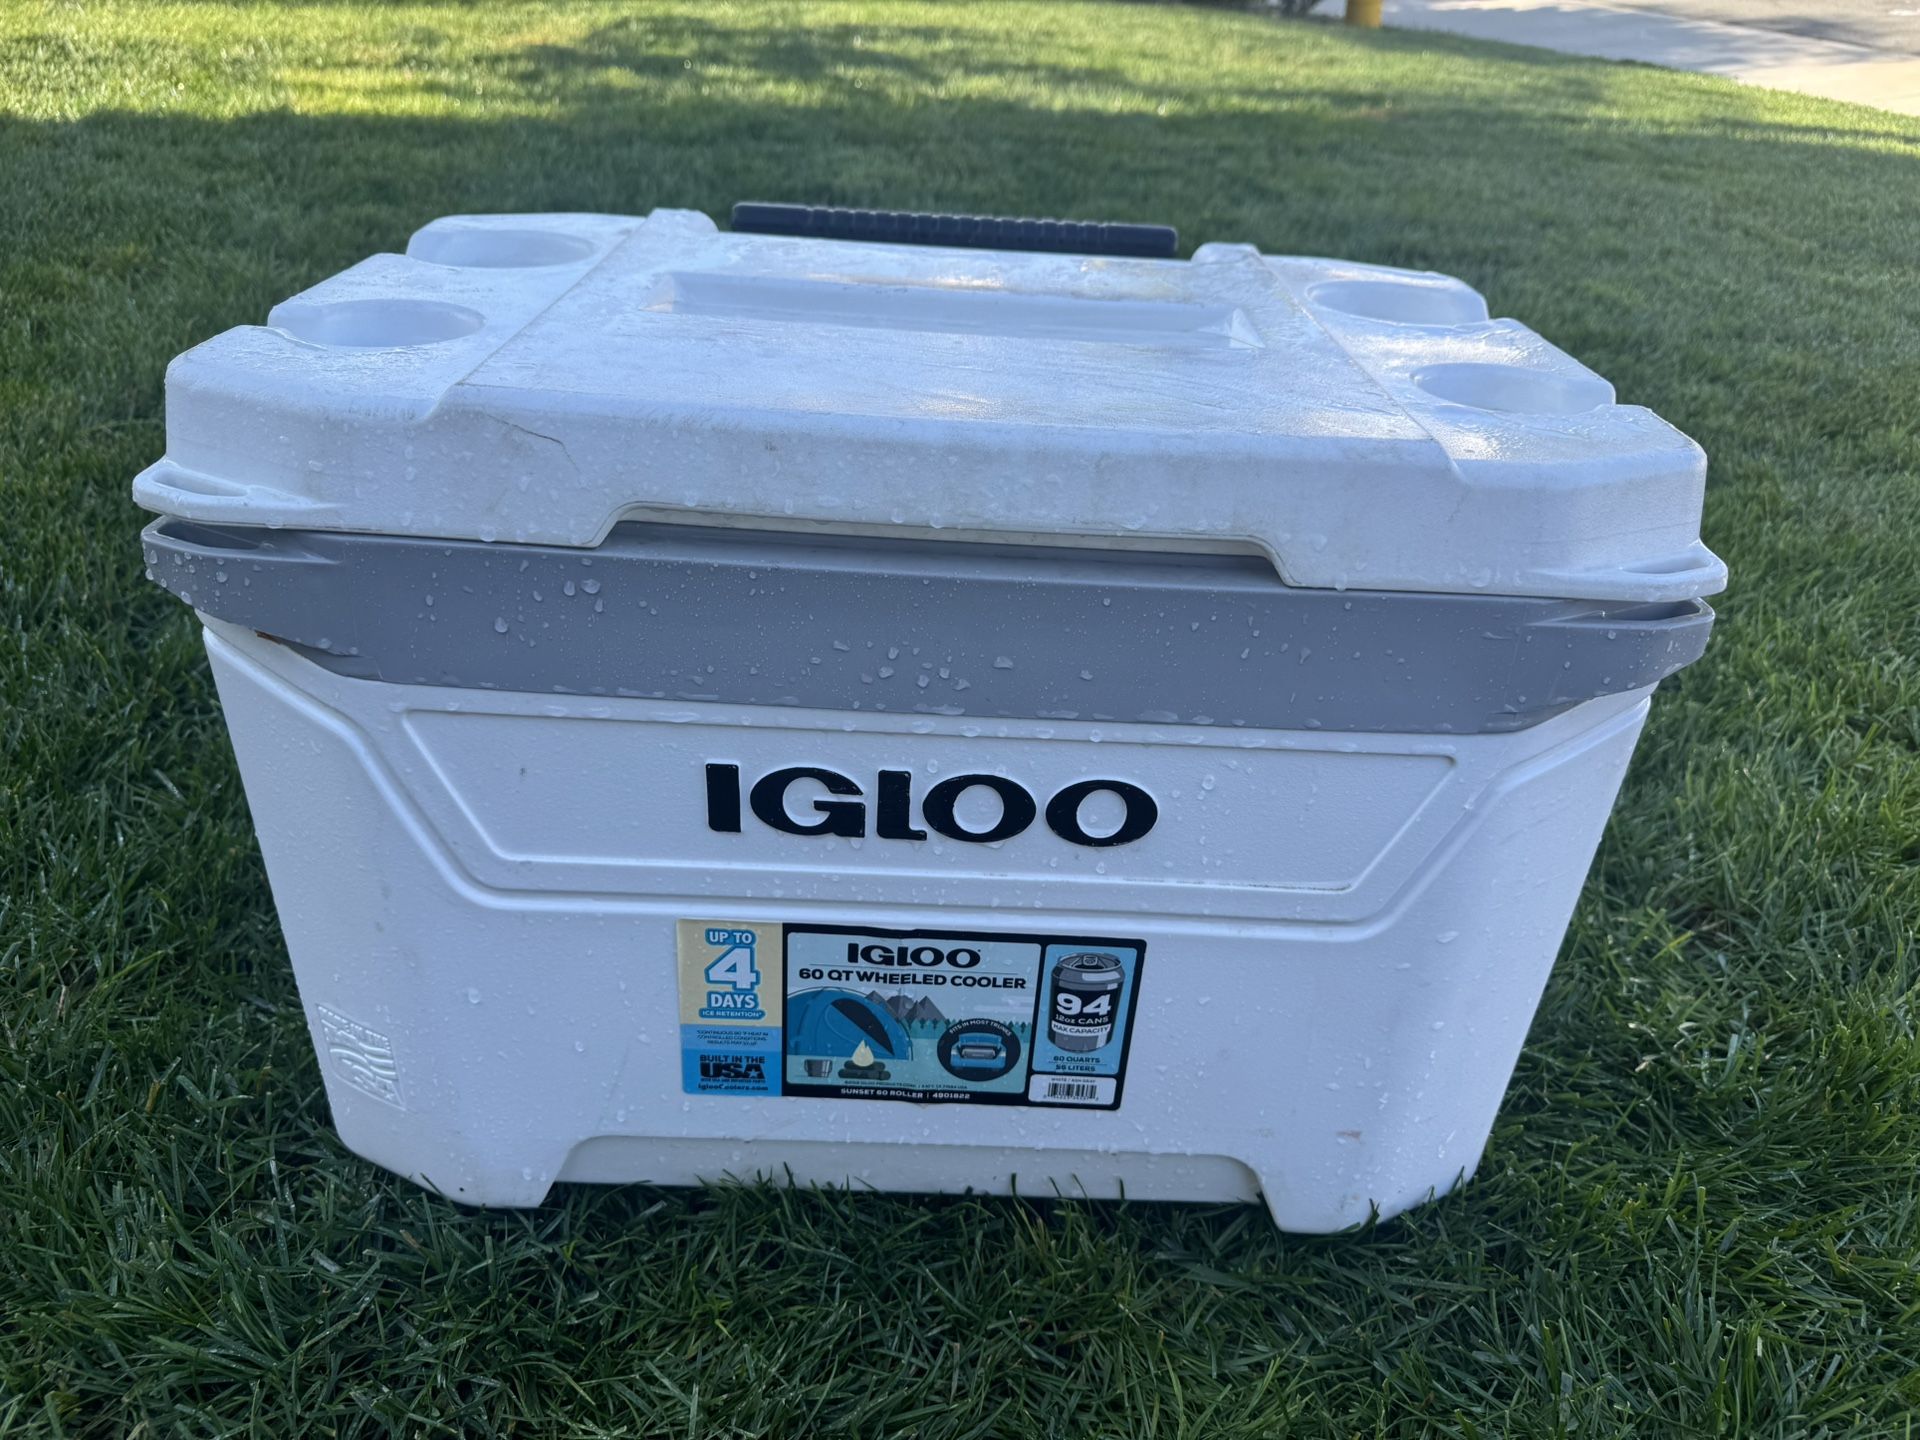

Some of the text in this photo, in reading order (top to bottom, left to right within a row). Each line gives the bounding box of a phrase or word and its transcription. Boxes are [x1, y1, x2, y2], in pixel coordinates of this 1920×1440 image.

[706, 763, 1158, 847] IGLOO
[709, 931, 752, 944] UP TO
[847, 942, 980, 969] IGLOO
[709, 947, 757, 989] 4
[799, 968, 1026, 989] 60 QT WHEELED COOLER
[710, 993, 755, 1009] DAYS
[1056, 992, 1111, 1016] 94
[1078, 1015, 1109, 1024] CANS
[1053, 1023, 1109, 1034] MAX CAPACITY
[699, 1054, 765, 1064] BUILT IN THE
[700, 1062, 765, 1080] USA
[840, 1087, 875, 1095] SUNSET
[889, 1089, 923, 1098] ROLLER
